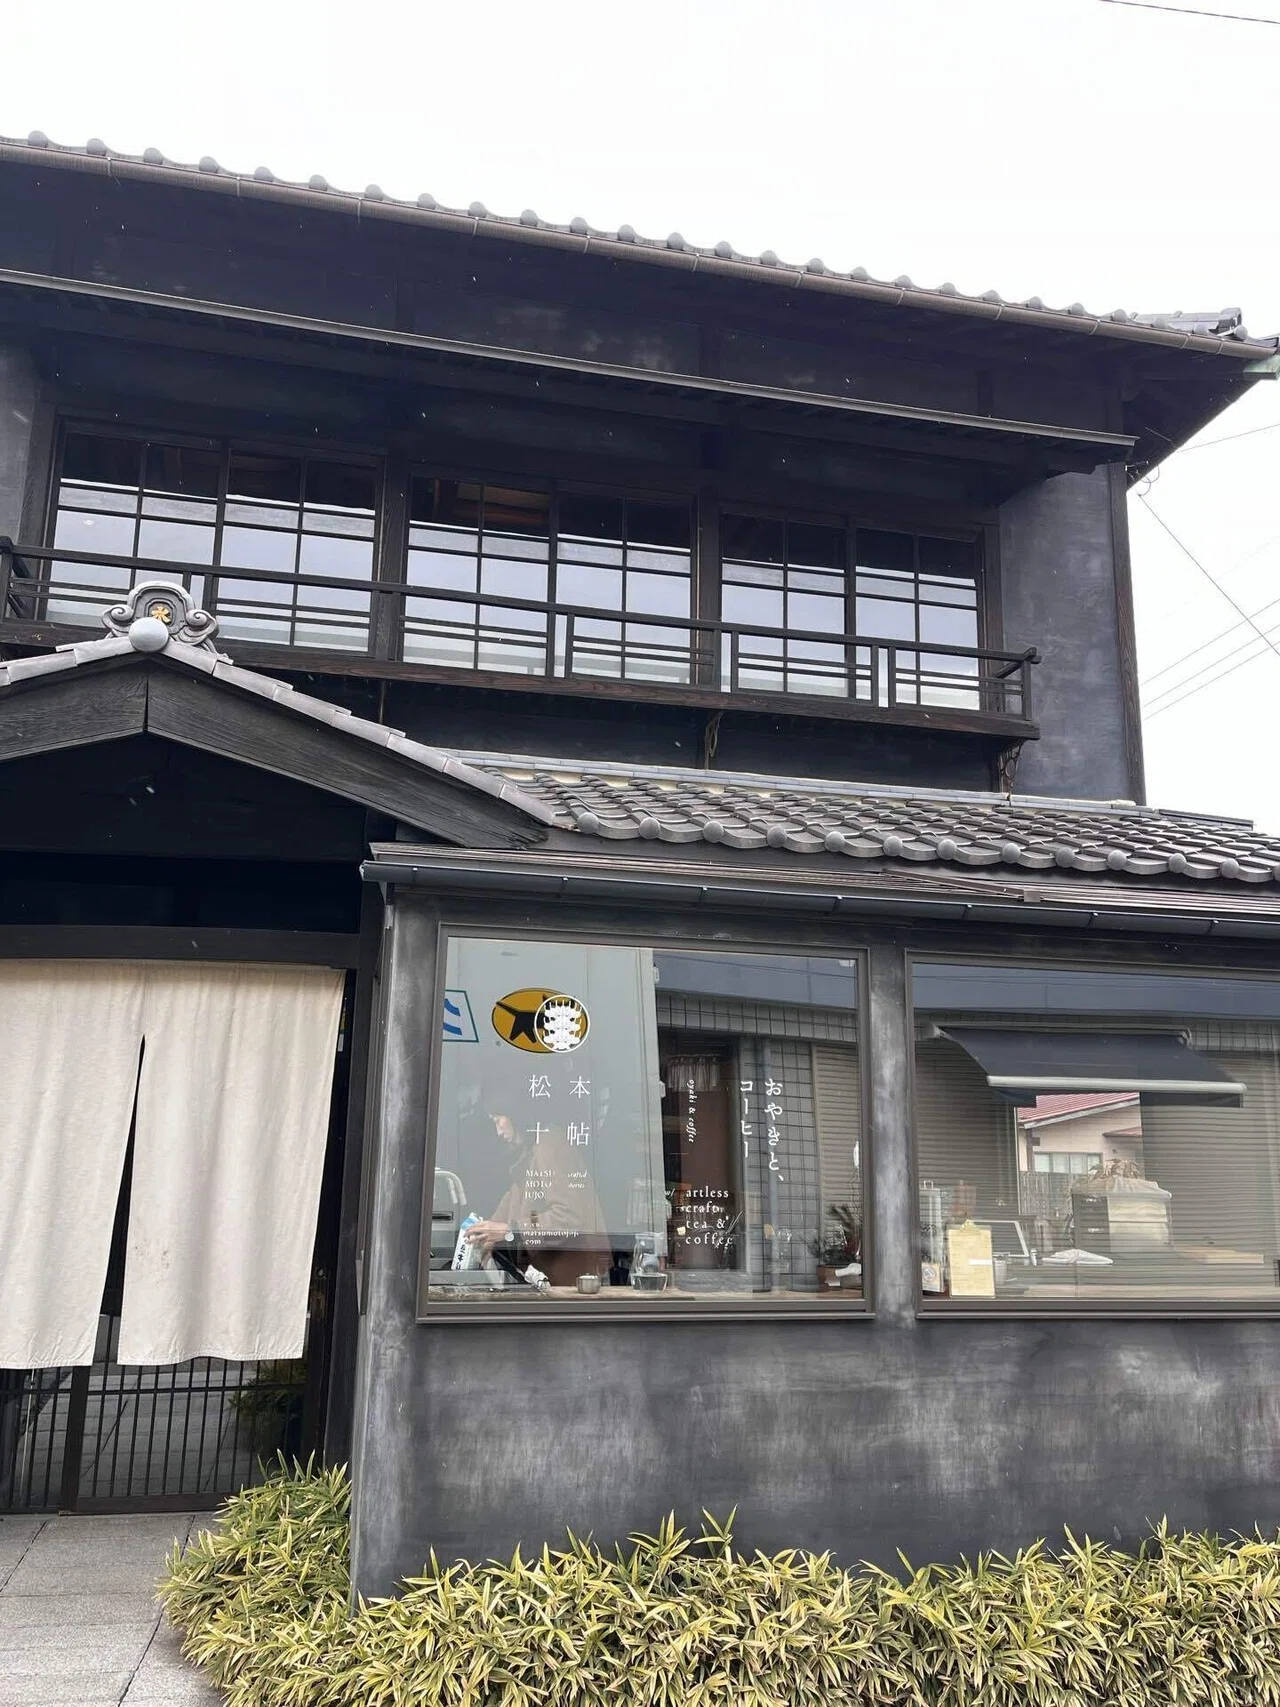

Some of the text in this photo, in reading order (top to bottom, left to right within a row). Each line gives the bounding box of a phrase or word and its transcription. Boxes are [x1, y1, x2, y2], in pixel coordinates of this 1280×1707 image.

[528, 1074, 591, 1099] 松本
[688, 1106, 696, 1115] &
[739, 1080, 754, 1158] コーヒー
[526, 1121, 590, 1146] 十帖
[685, 1117, 697, 1144] coffee
[763, 1078, 784, 1182] おやきと、
[525, 1190, 545, 1200] JUJO
[685, 1185, 730, 1199] artless
[686, 1218, 726, 1230] tea &
[685, 1231, 734, 1245] coffee
